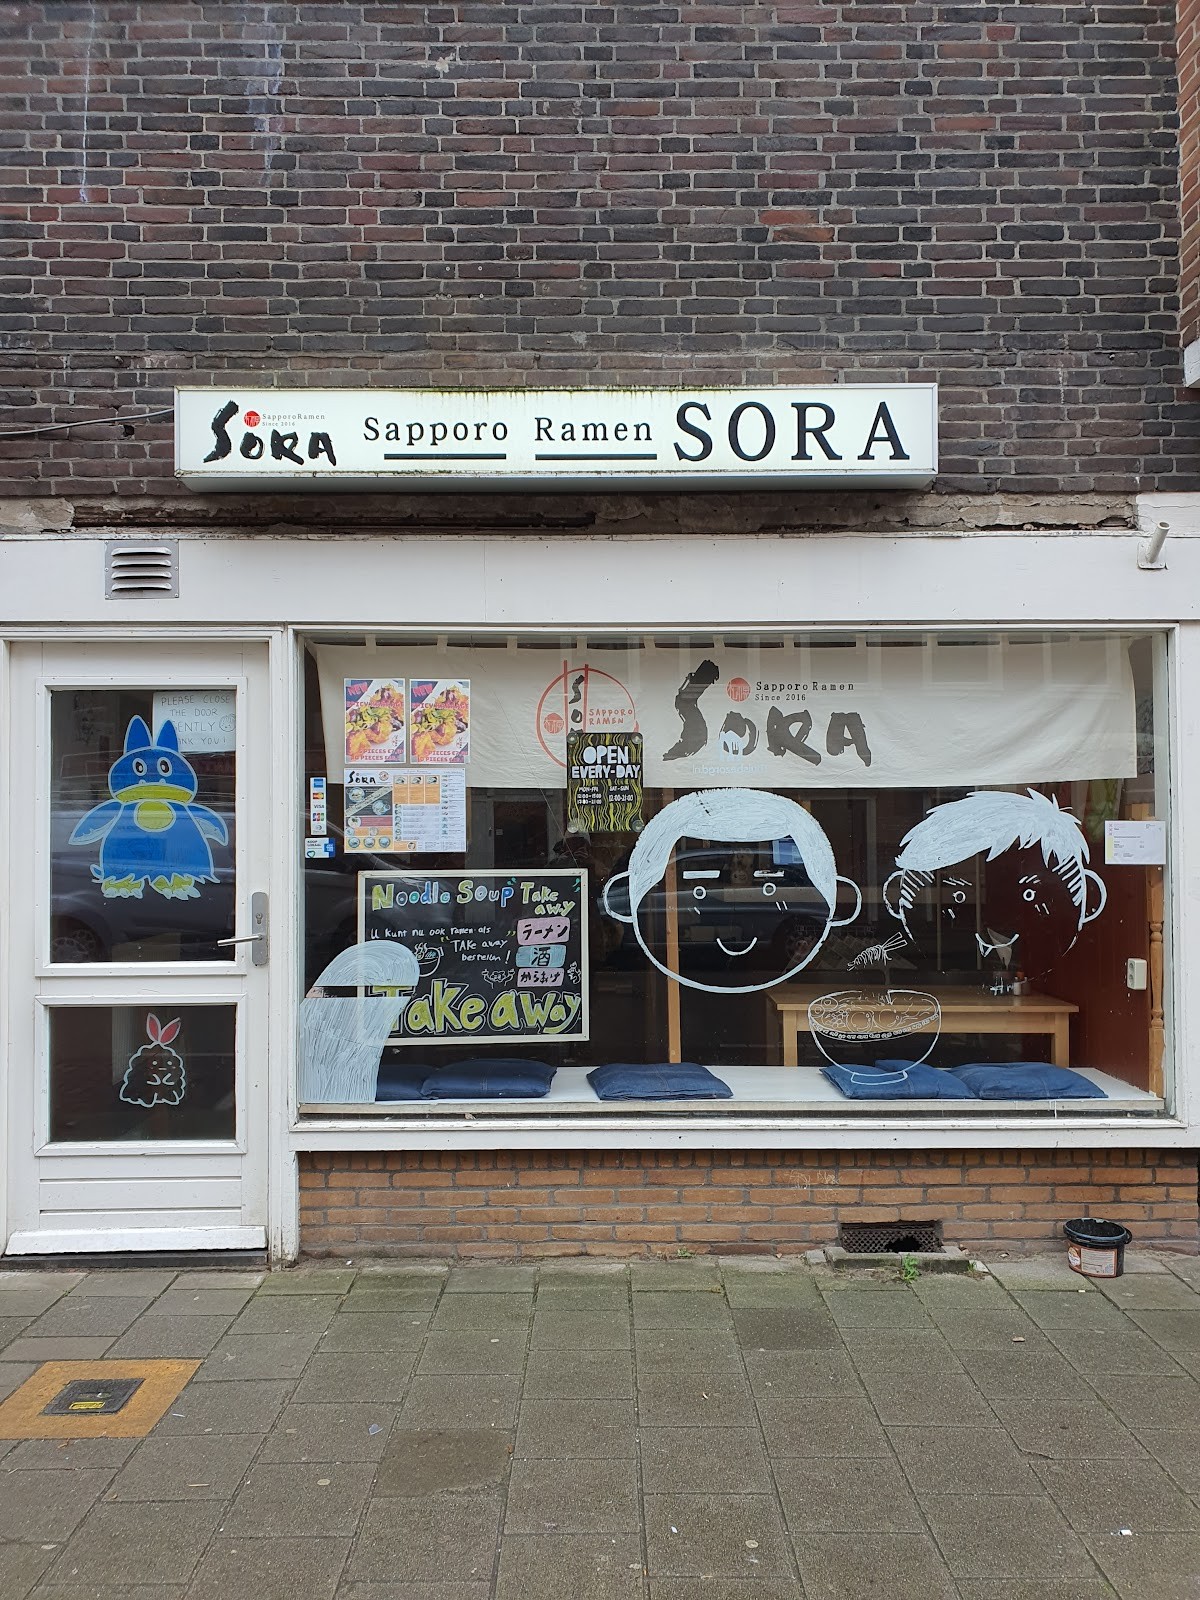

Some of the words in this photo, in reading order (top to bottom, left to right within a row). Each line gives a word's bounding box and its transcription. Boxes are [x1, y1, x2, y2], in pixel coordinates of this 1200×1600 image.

[203, 400, 336, 466] SORA
[363, 416, 509, 446] Sapporo
[534, 416, 653, 442] Ramen
[673, 401, 910, 462] SORA
[755, 681, 808, 692] Sapporo
[812, 681, 854, 691] Ramen
[161, 695, 194, 706] PLEASE
[203, 695, 231, 704] CLOSE
[755, 693, 781, 701] Since
[786, 693, 806, 701] 2016
[170, 709, 186, 717] THE
[194, 708, 218, 717] DOOR
[588, 708, 633, 717] SAPPORO
[662, 659, 872, 767] SORA
[588, 717, 624, 725] RAMEN
[583, 745, 629, 764] OPEN
[348, 770, 377, 785] SORA
[571, 765, 641, 779] EVERY-DAY
[371, 881, 450, 911] Noodle
[456, 879, 514, 908] Soup
[412, 928, 425, 937] nu
[429, 927, 446, 936] ook
[477, 926, 491, 935] als
[522, 923, 569, 941] ラーメン
[530, 946, 551, 966] 酒
[489, 990, 581, 1034] away
